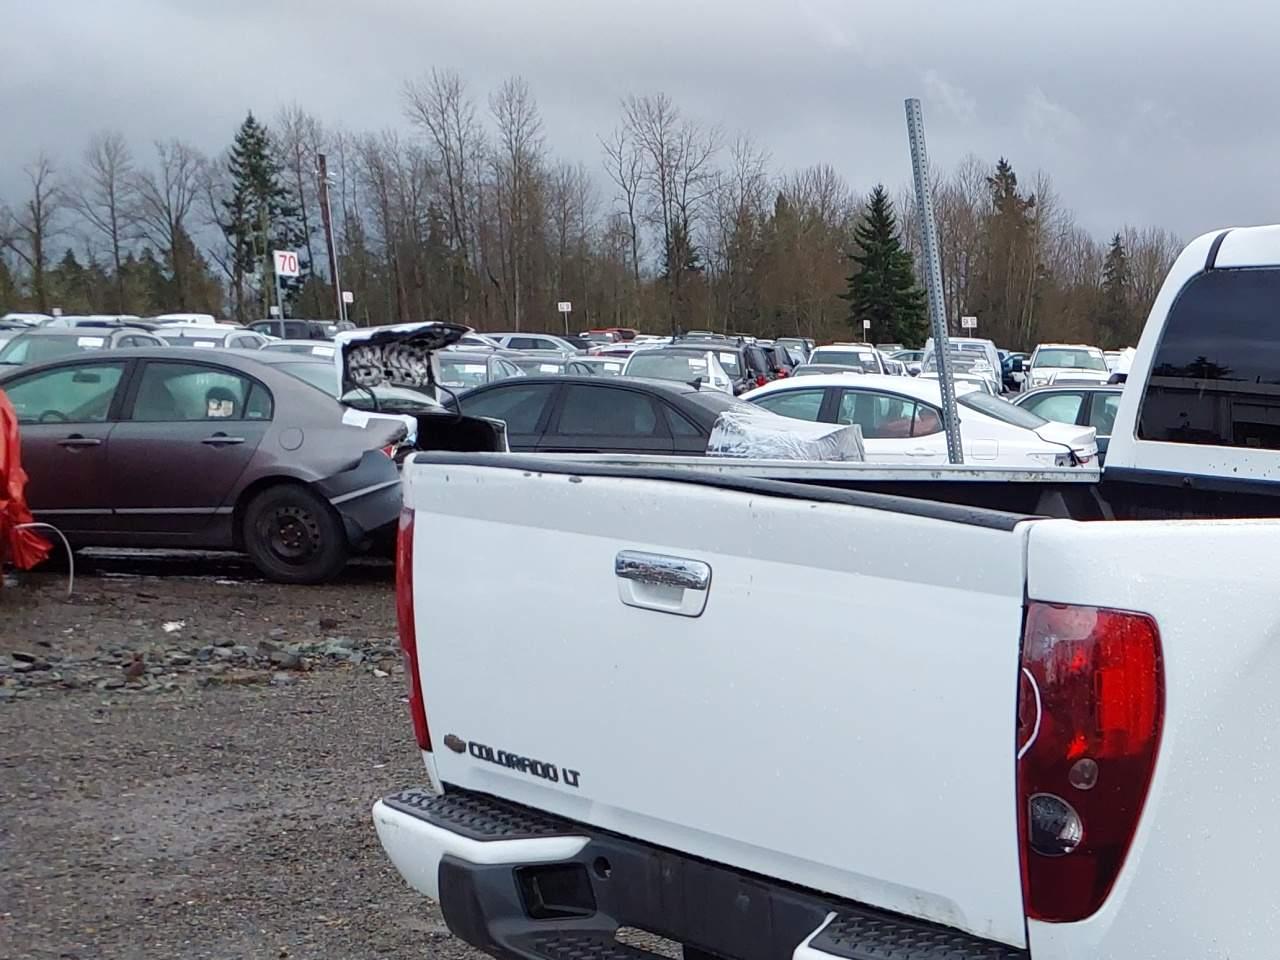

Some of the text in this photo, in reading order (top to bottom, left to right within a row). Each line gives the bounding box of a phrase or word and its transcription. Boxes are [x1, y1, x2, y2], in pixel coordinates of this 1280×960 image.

[278, 254, 297, 273] 70
[468, 740, 581, 788] COLORADO LT
